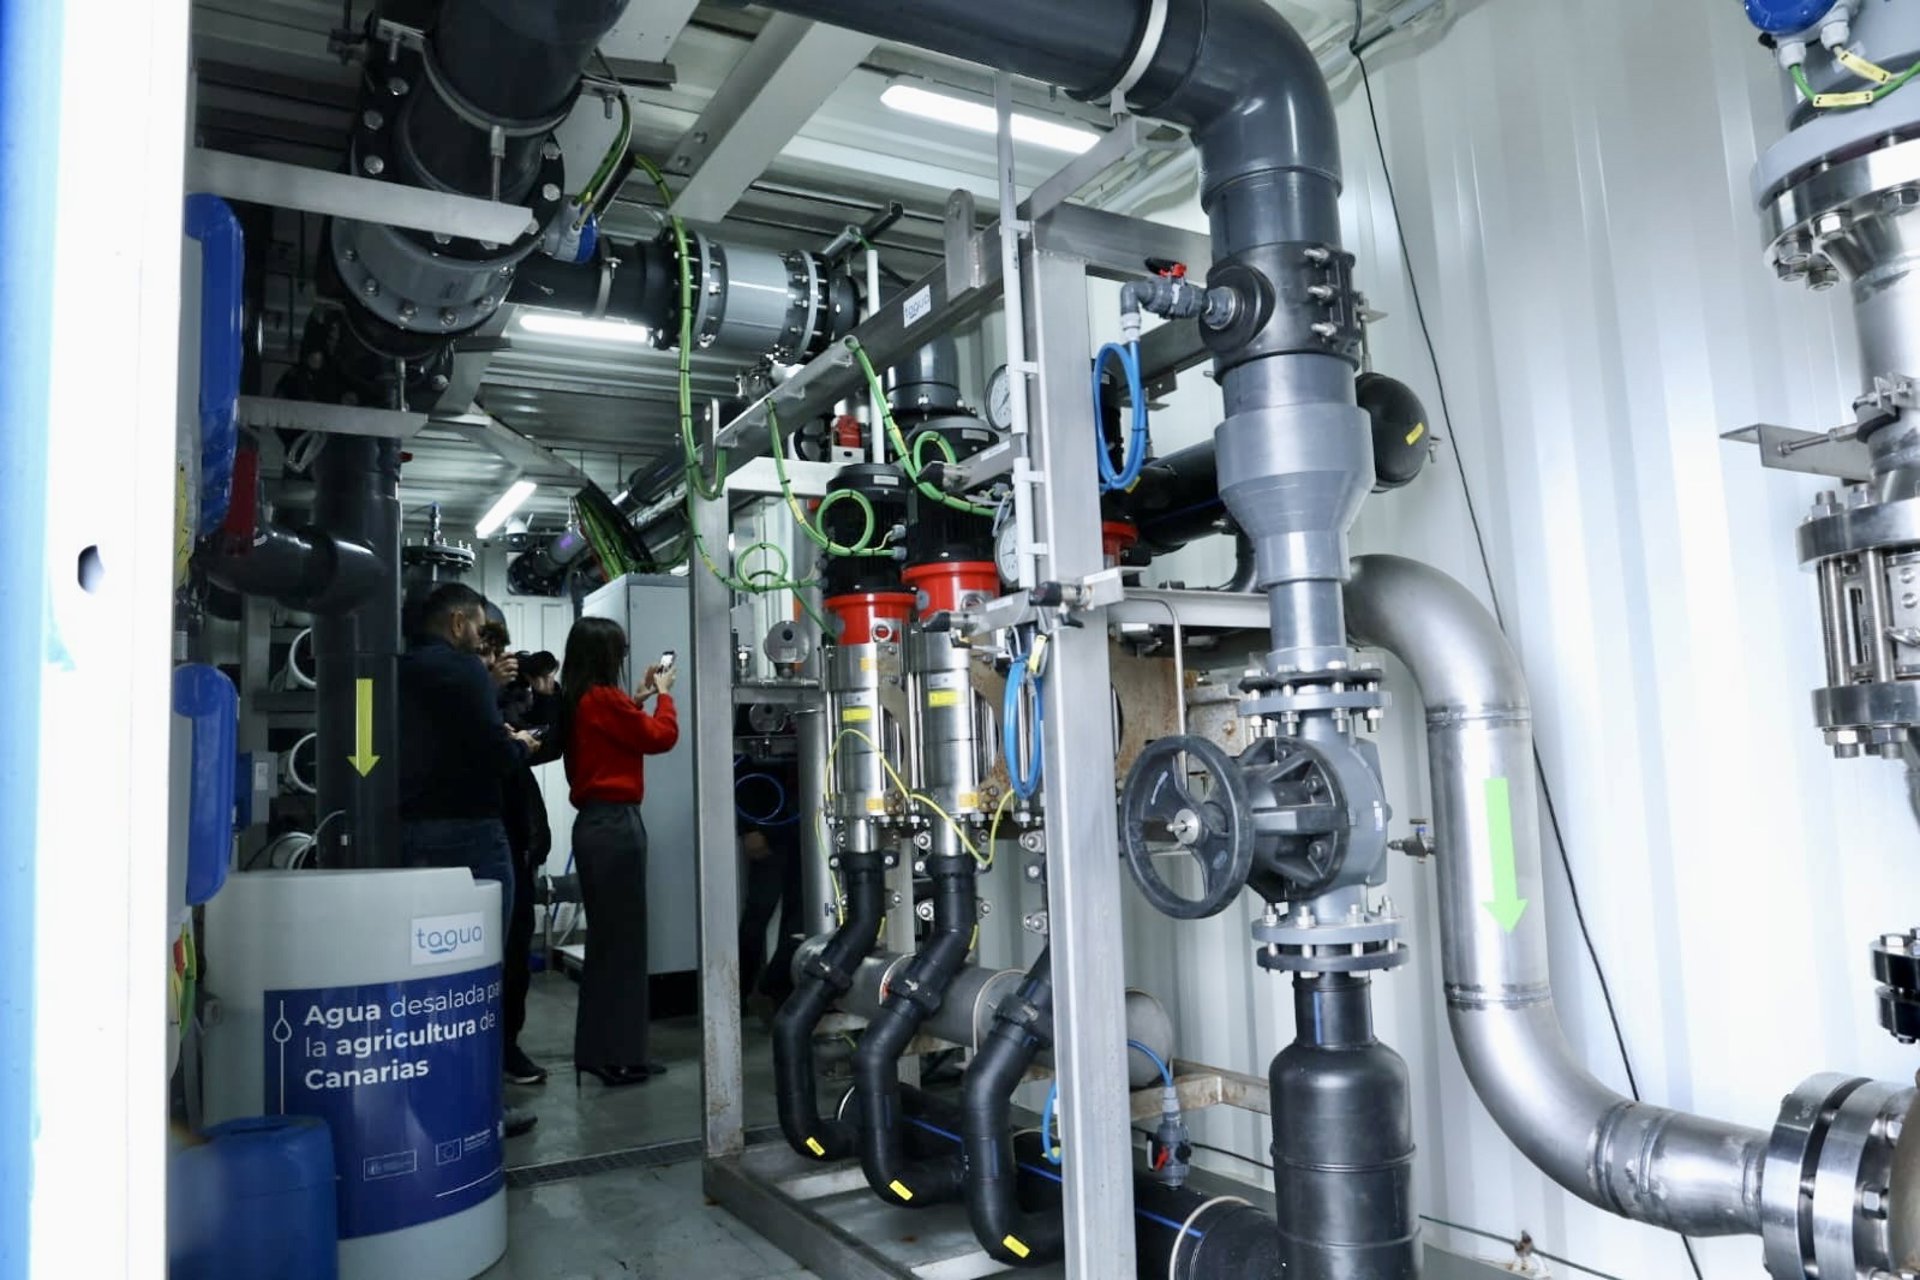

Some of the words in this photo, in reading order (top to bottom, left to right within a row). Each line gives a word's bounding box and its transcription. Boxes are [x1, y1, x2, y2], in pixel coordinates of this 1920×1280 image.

[415, 924, 483, 954] tagua
[304, 1004, 381, 1029] Agua
[390, 983, 485, 1018] desalada
[305, 1037, 327, 1058] la
[336, 1018, 477, 1059] agricultura
[480, 1009, 496, 1031] de
[304, 1059, 430, 1091] Canarias
